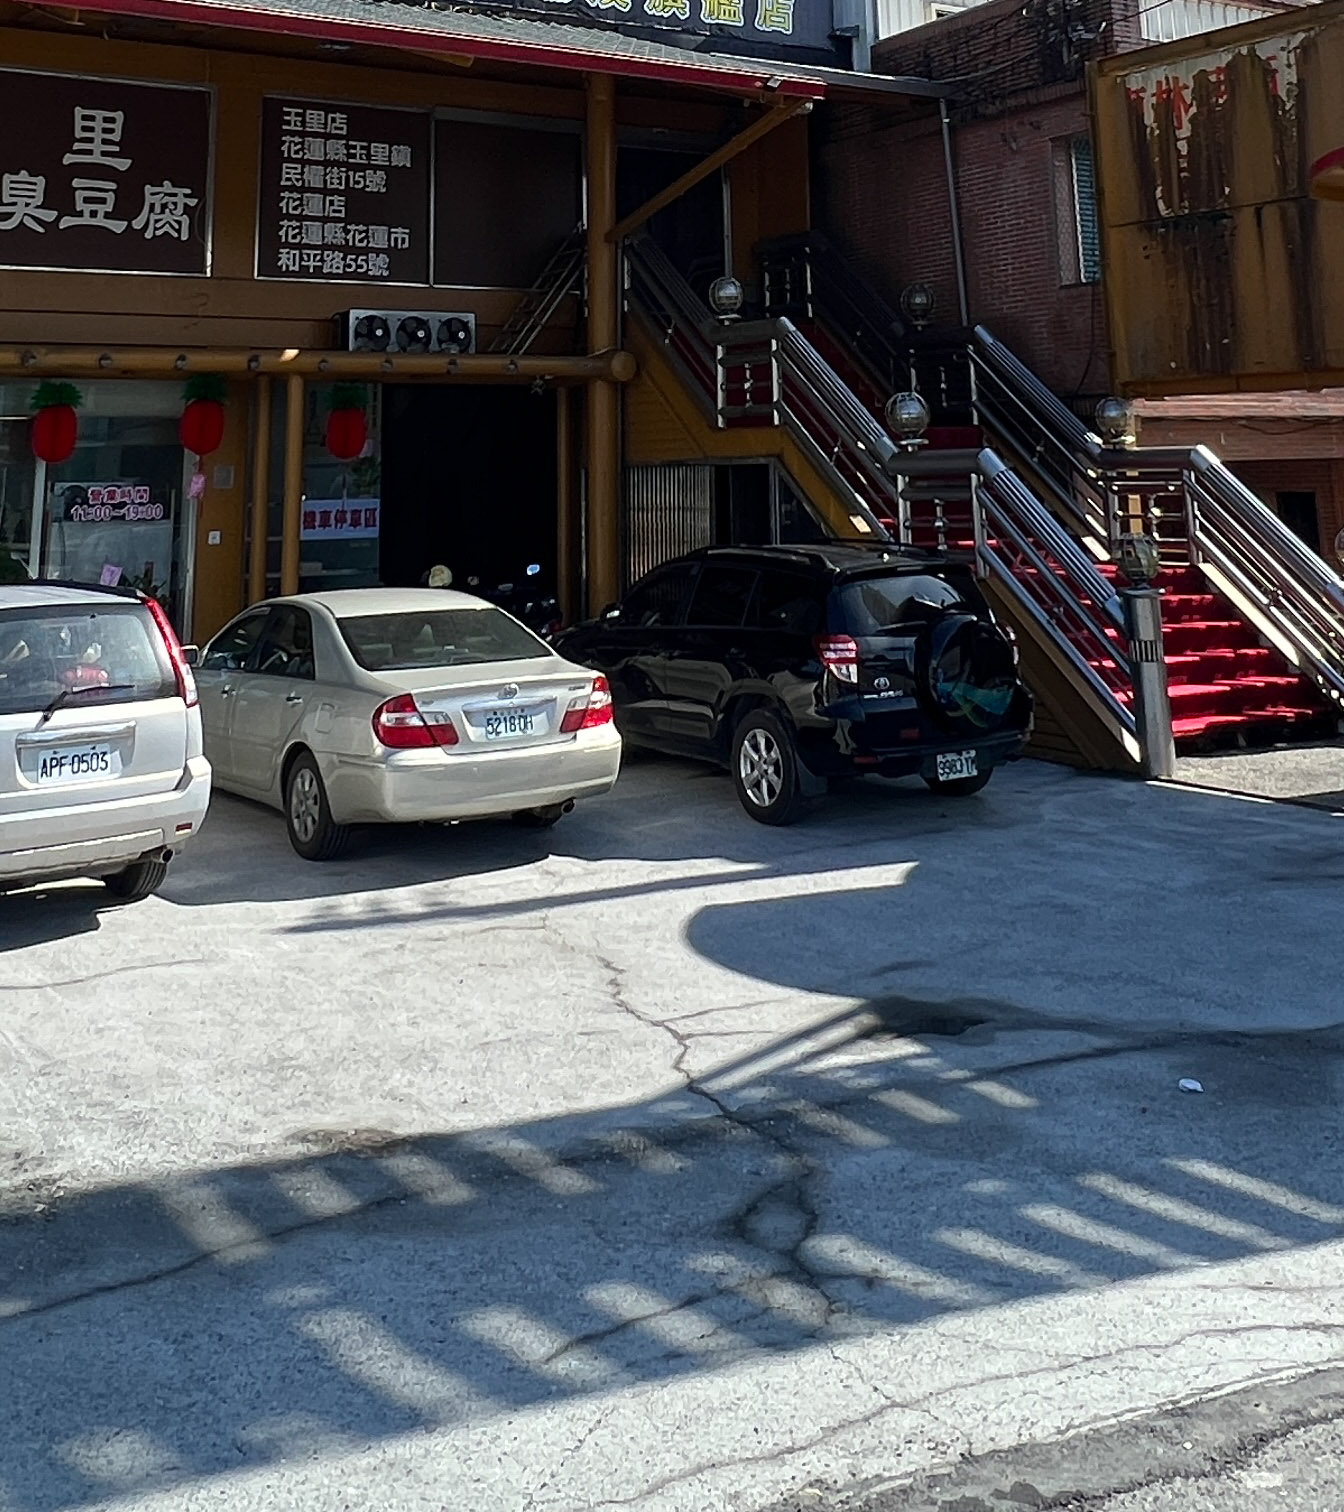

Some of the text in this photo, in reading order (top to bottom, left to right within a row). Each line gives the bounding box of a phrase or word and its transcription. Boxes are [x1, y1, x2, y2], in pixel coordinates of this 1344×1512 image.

[282, 107, 348, 135] 玉里店
[281, 136, 412, 167] 花蓮縣玉里鎮
[280, 163, 387, 192] 民權街15號
[279, 191, 346, 218] 花蓮店
[278, 219, 410, 249] 花蓮縣花蓮市
[277, 249, 390, 277] 和平路55號
[40, 751, 109, 778] APF-0503
